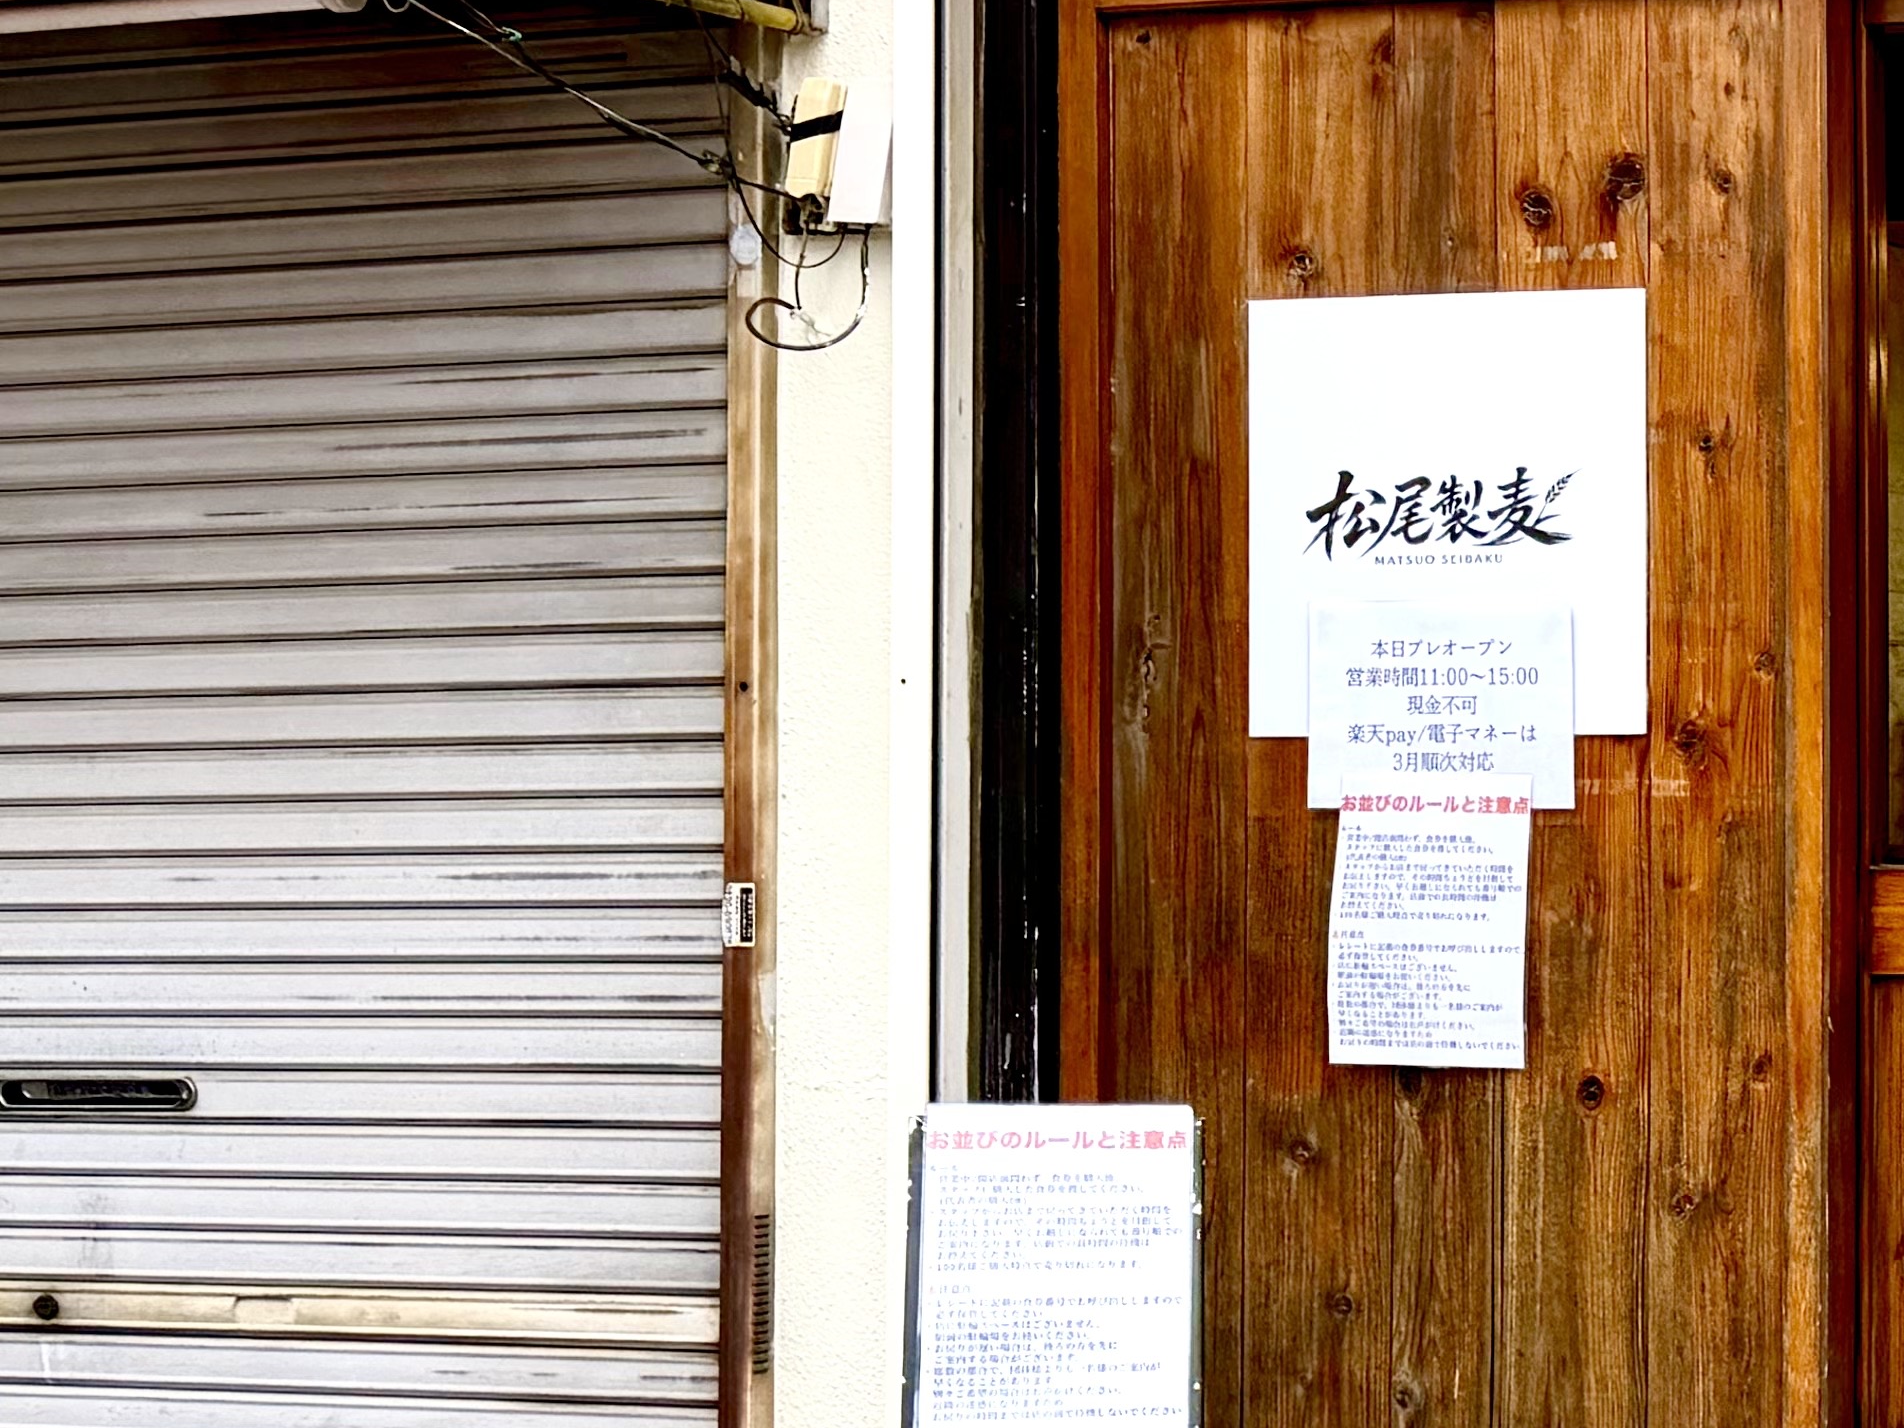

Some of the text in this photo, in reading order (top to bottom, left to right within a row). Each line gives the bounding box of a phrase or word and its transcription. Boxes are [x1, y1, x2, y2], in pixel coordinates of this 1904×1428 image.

[1302, 467, 1574, 561] 松尾製麦
[1375, 554, 1503, 565] MATSUO SEIBAKU
[1370, 638, 1513, 659] 本日プレオープン
[1406, 695, 1478, 715] 現金不可
[1347, 723, 1538, 746] 楽天pay/電子マネーは
[1393, 751, 1495, 773] 3月順次対応
[1340, 793, 1530, 814] お並びのルールと注意点
[927, 1130, 1187, 1150] お並びのルールと注意点
